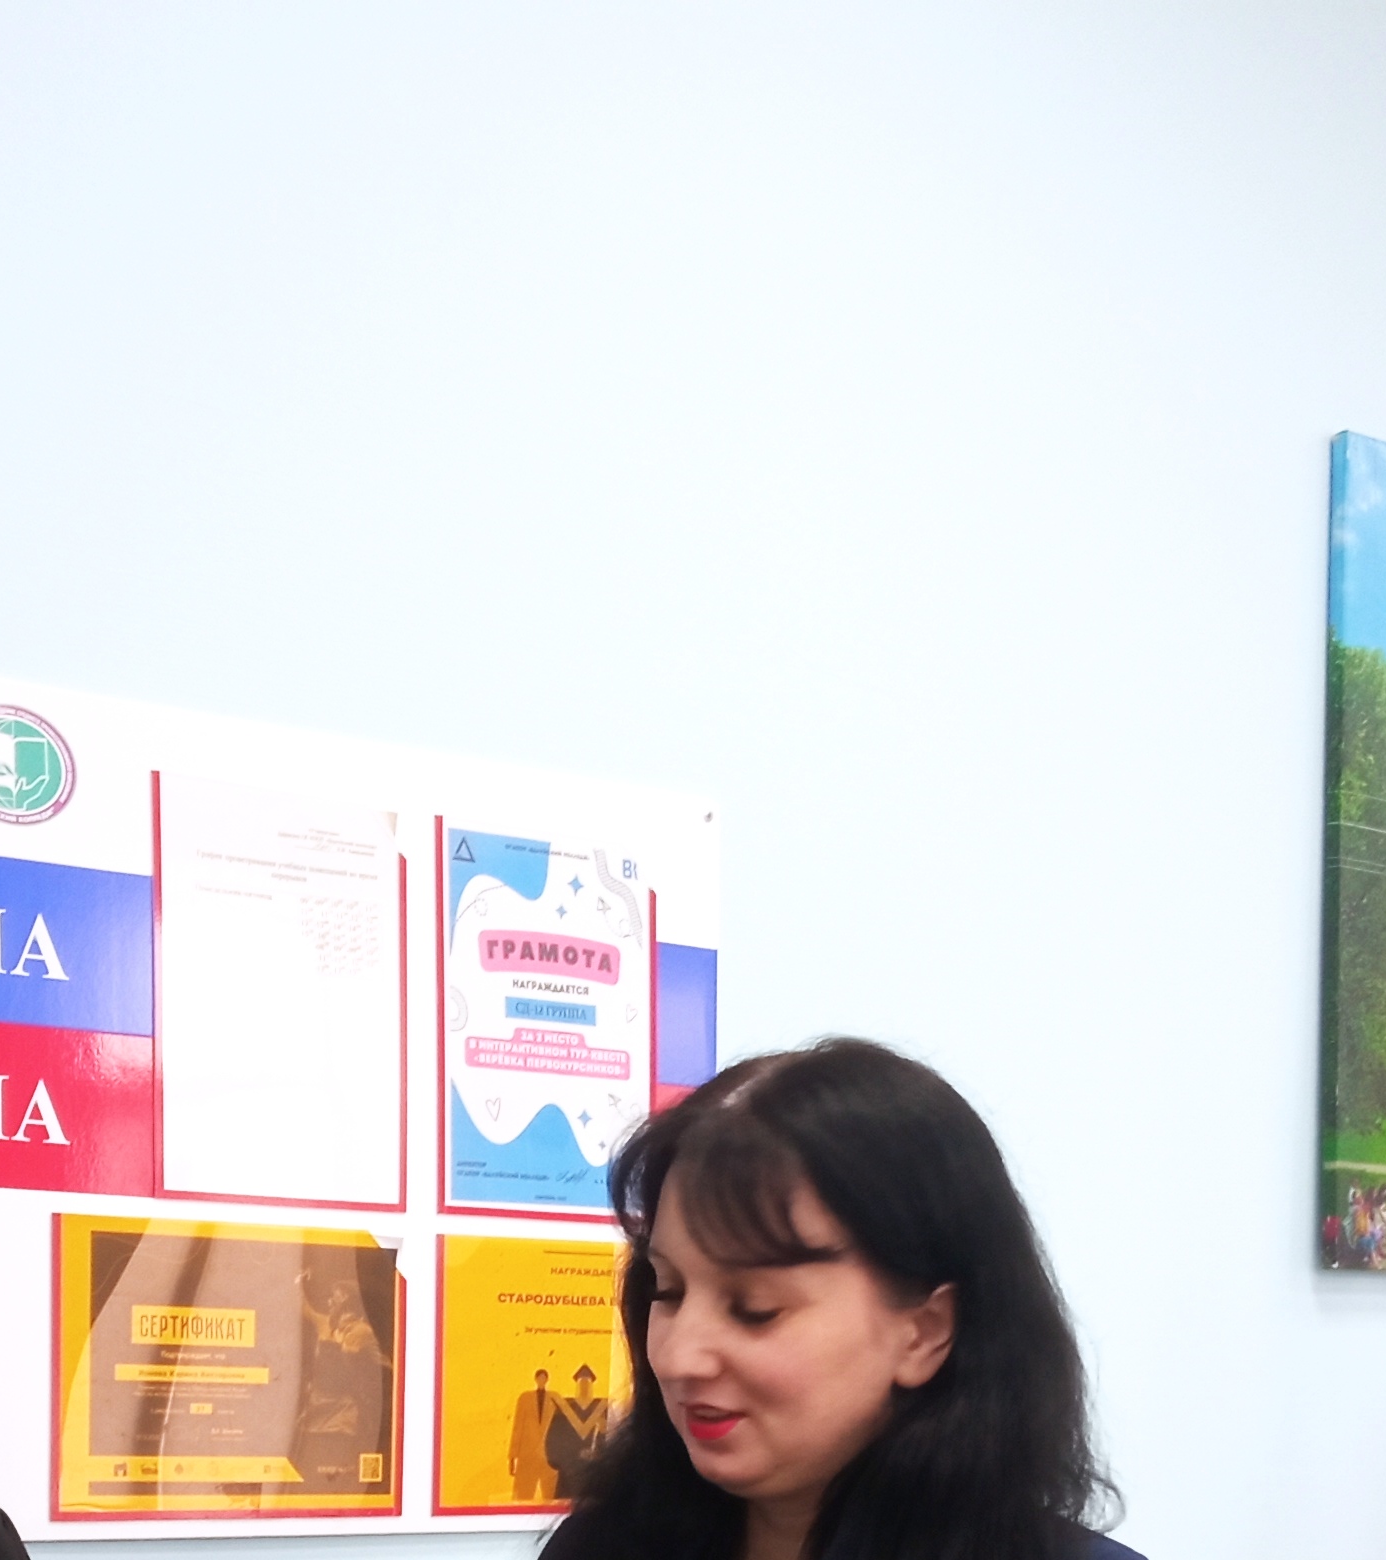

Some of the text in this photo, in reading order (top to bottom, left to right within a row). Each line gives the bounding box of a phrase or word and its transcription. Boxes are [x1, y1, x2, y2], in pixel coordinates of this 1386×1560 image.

[487, 940, 612, 973] ГРАМОТА
[512, 979, 590, 995] НАГРАЖДАЕТСЯ
[544, 1033, 579, 1046] МЕСТО
[478, 1040, 568, 1058] ИНТЕРАКТИВНОМ
[550, 1267, 614, 1277] НАГРАЖДАЕ
[498, 1293, 606, 1306] СТАРОДУБЦЕВА
[140, 1313, 245, 1341] СЕРТИФИКАТ
